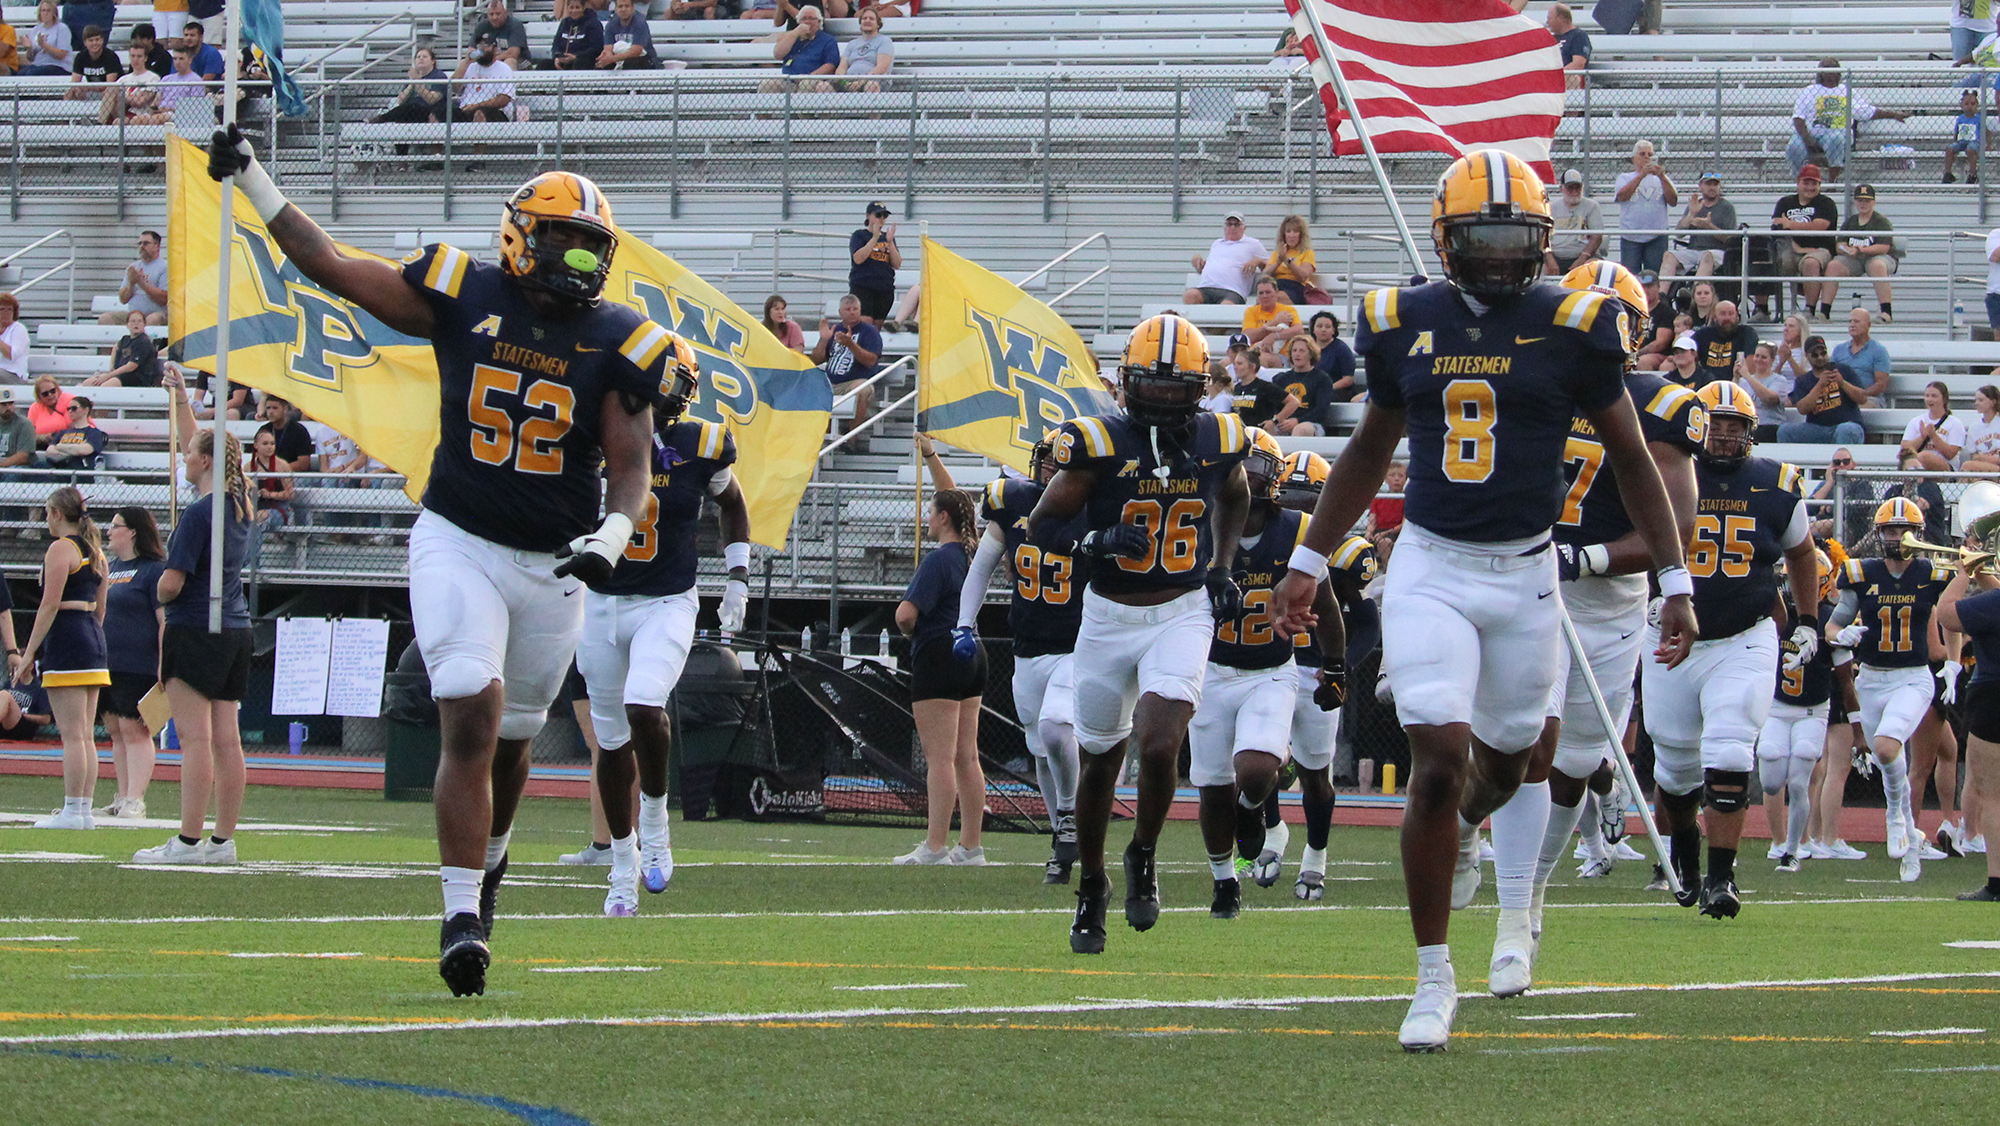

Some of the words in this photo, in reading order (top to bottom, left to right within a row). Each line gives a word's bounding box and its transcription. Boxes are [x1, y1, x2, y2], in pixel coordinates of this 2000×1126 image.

[492, 341, 569, 378] STATESMEN
[1431, 355, 1512, 376] STATESMEN
[467, 362, 577, 476] 52
[1442, 378, 1498, 484] 8
[1700, 498, 1748, 512] STATESMEN
[1115, 498, 1207, 575] 86
[1685, 514, 1757, 579] 65
[1014, 543, 1074, 605] 93
[1877, 594, 1916, 605] STATESMEN
[1877, 605, 1913, 653] 11
